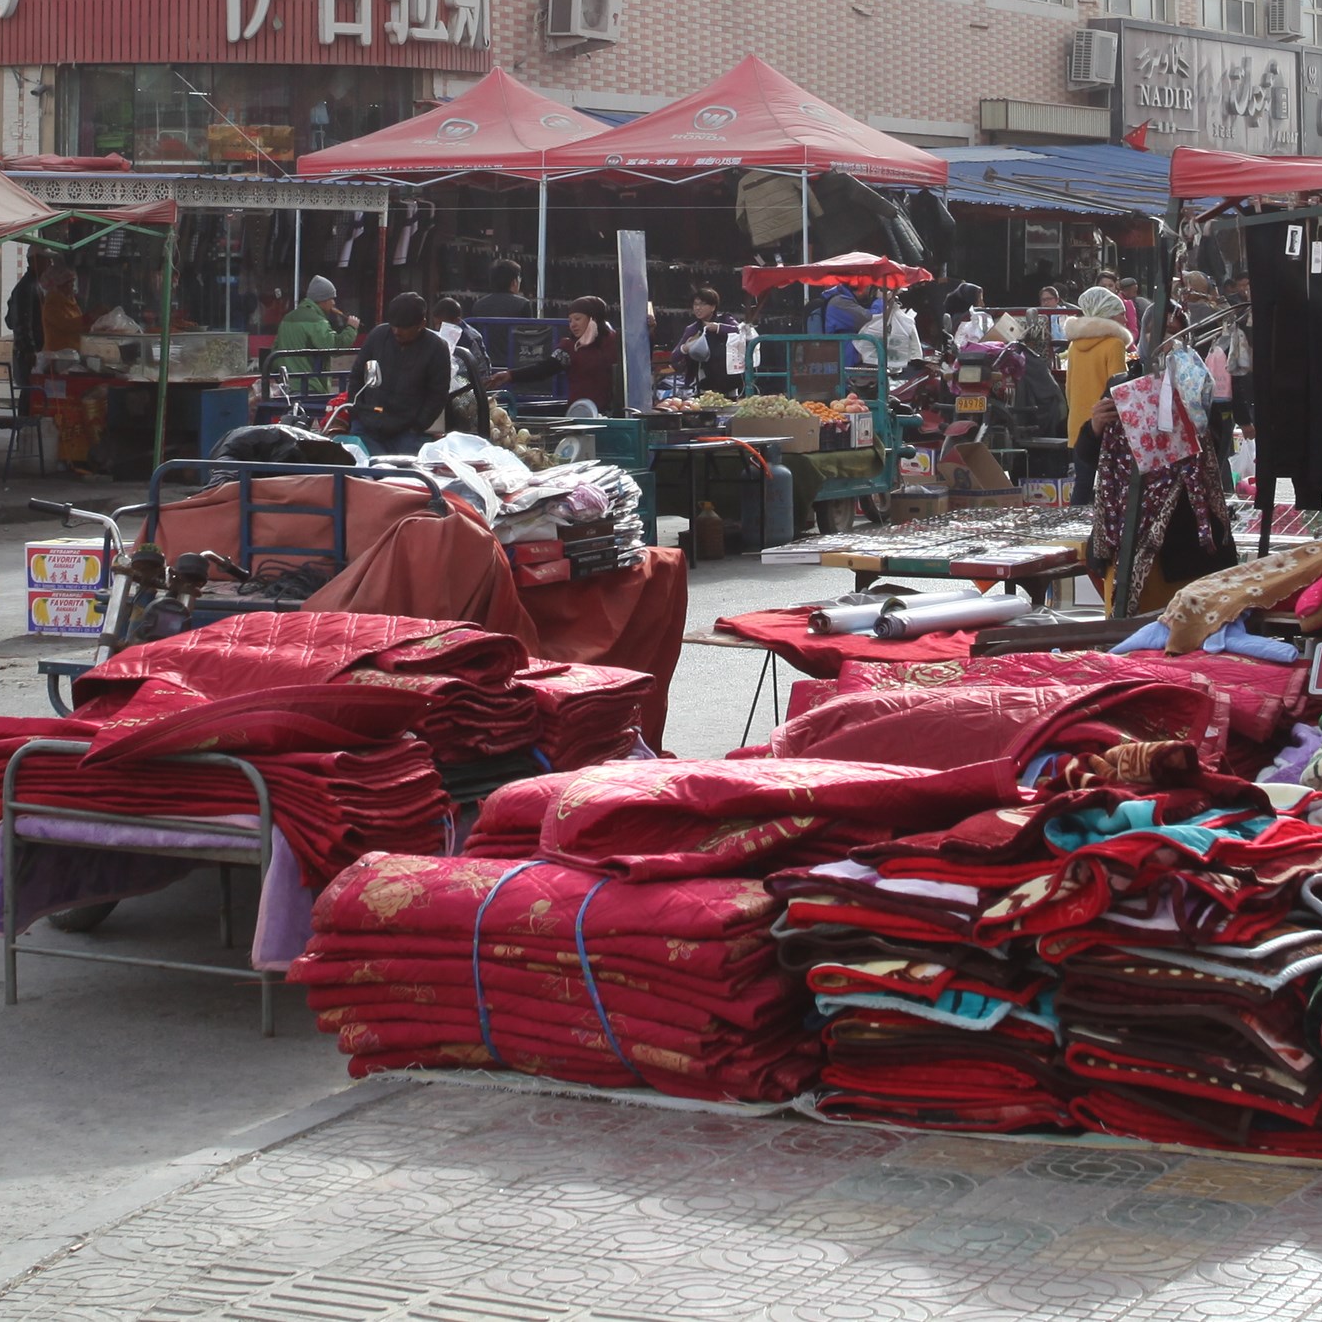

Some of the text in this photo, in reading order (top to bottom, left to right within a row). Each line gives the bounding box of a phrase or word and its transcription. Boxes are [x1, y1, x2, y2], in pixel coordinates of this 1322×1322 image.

[1139, 83, 1193, 110] NADIR
[670, 133, 728, 142] HONDA
[48, 556, 81, 564] FAVORITA
[50, 599, 84, 607] FAVORITA
